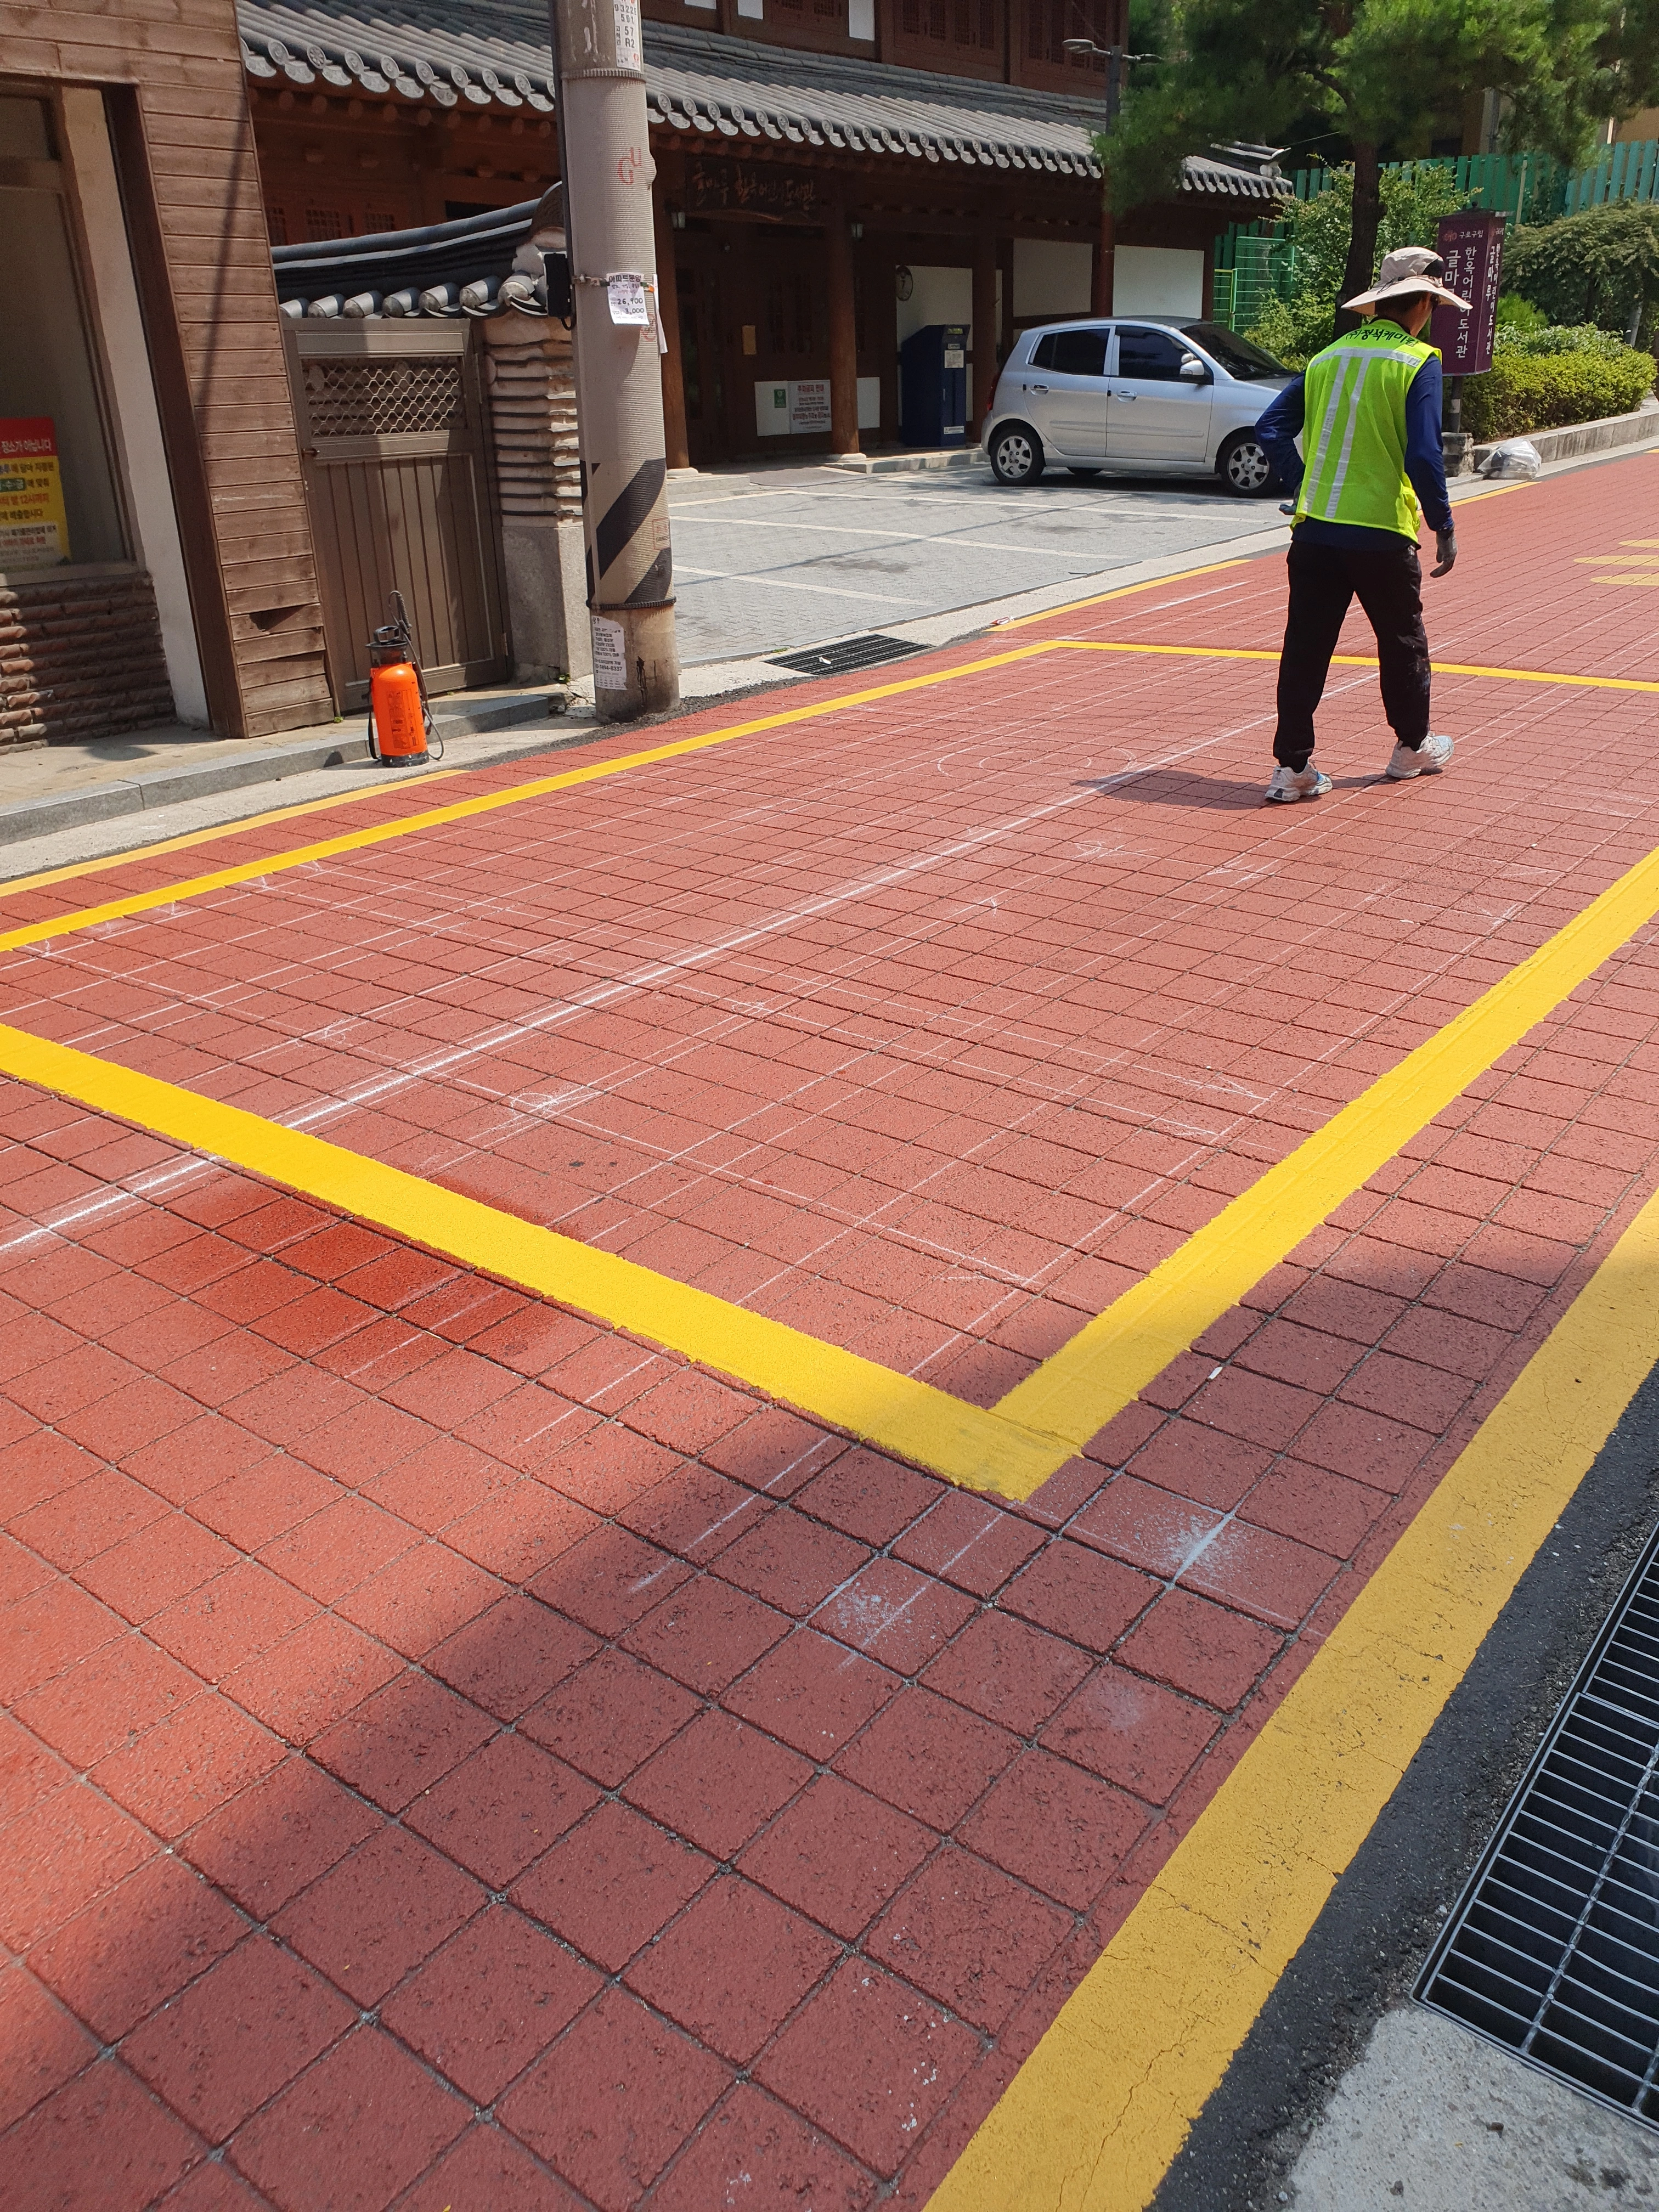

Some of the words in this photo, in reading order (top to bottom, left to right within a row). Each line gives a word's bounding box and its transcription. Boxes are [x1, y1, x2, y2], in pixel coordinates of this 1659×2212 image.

[1459, 230, 1483, 239] 구로구립
[1486, 246, 1496, 302] 글마루
[617, 297, 643, 306] 26,900
